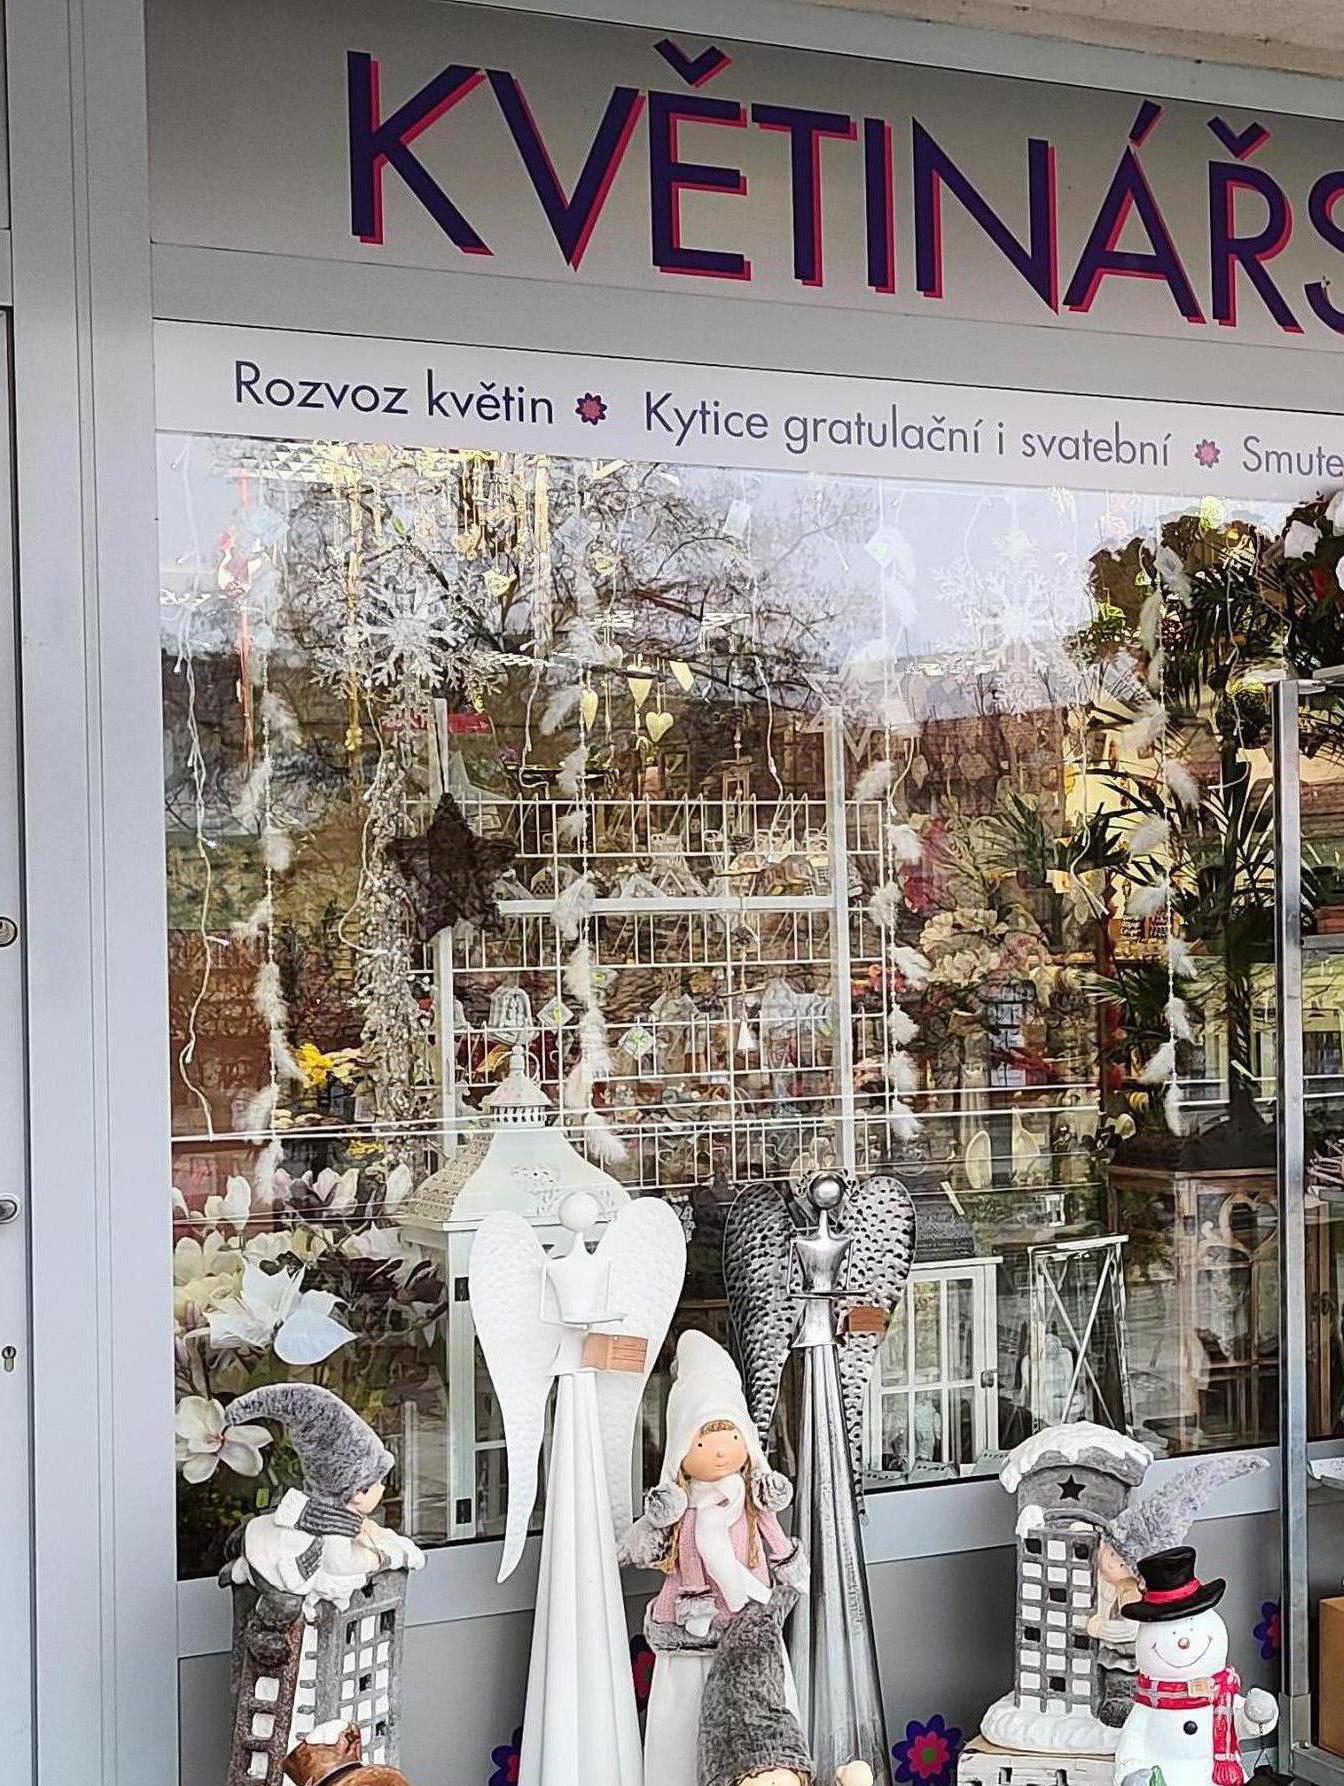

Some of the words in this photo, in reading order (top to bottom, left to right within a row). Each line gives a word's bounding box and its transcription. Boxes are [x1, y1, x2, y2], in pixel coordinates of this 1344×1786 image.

[235, 359, 409, 415] Rozvoz
[427, 368, 554, 425] květin
[645, 391, 769, 447] Kytice
[783, 403, 984, 454] gratulační
[998, 421, 1004, 455] i
[1021, 420, 1172, 467] svatební
